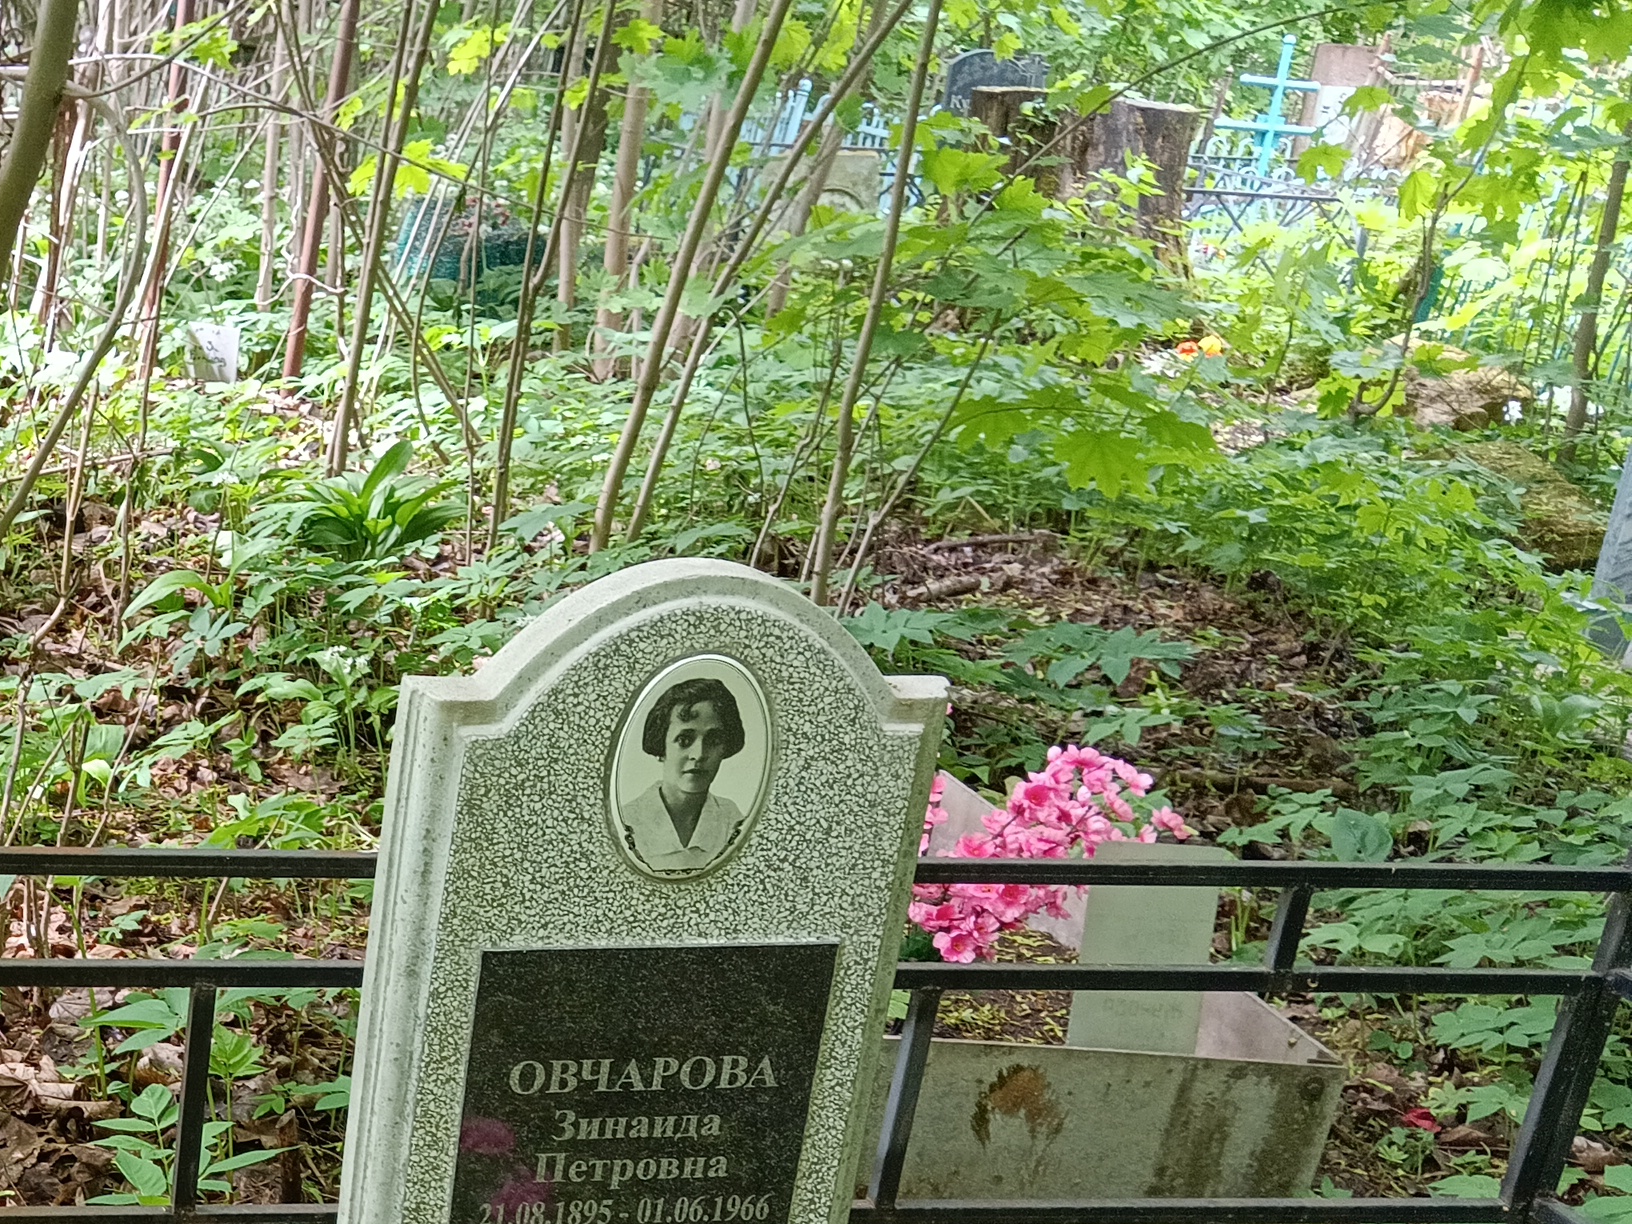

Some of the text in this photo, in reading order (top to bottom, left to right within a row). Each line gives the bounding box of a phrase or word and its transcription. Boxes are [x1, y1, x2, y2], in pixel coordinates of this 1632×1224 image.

[508, 1054, 780, 1095] ОВЧАРОВА
[551, 1109, 722, 1142] Зинаида
[532, 1152, 729, 1190] Петровна
[636, 1193, 774, 1224] 01.06.1966
